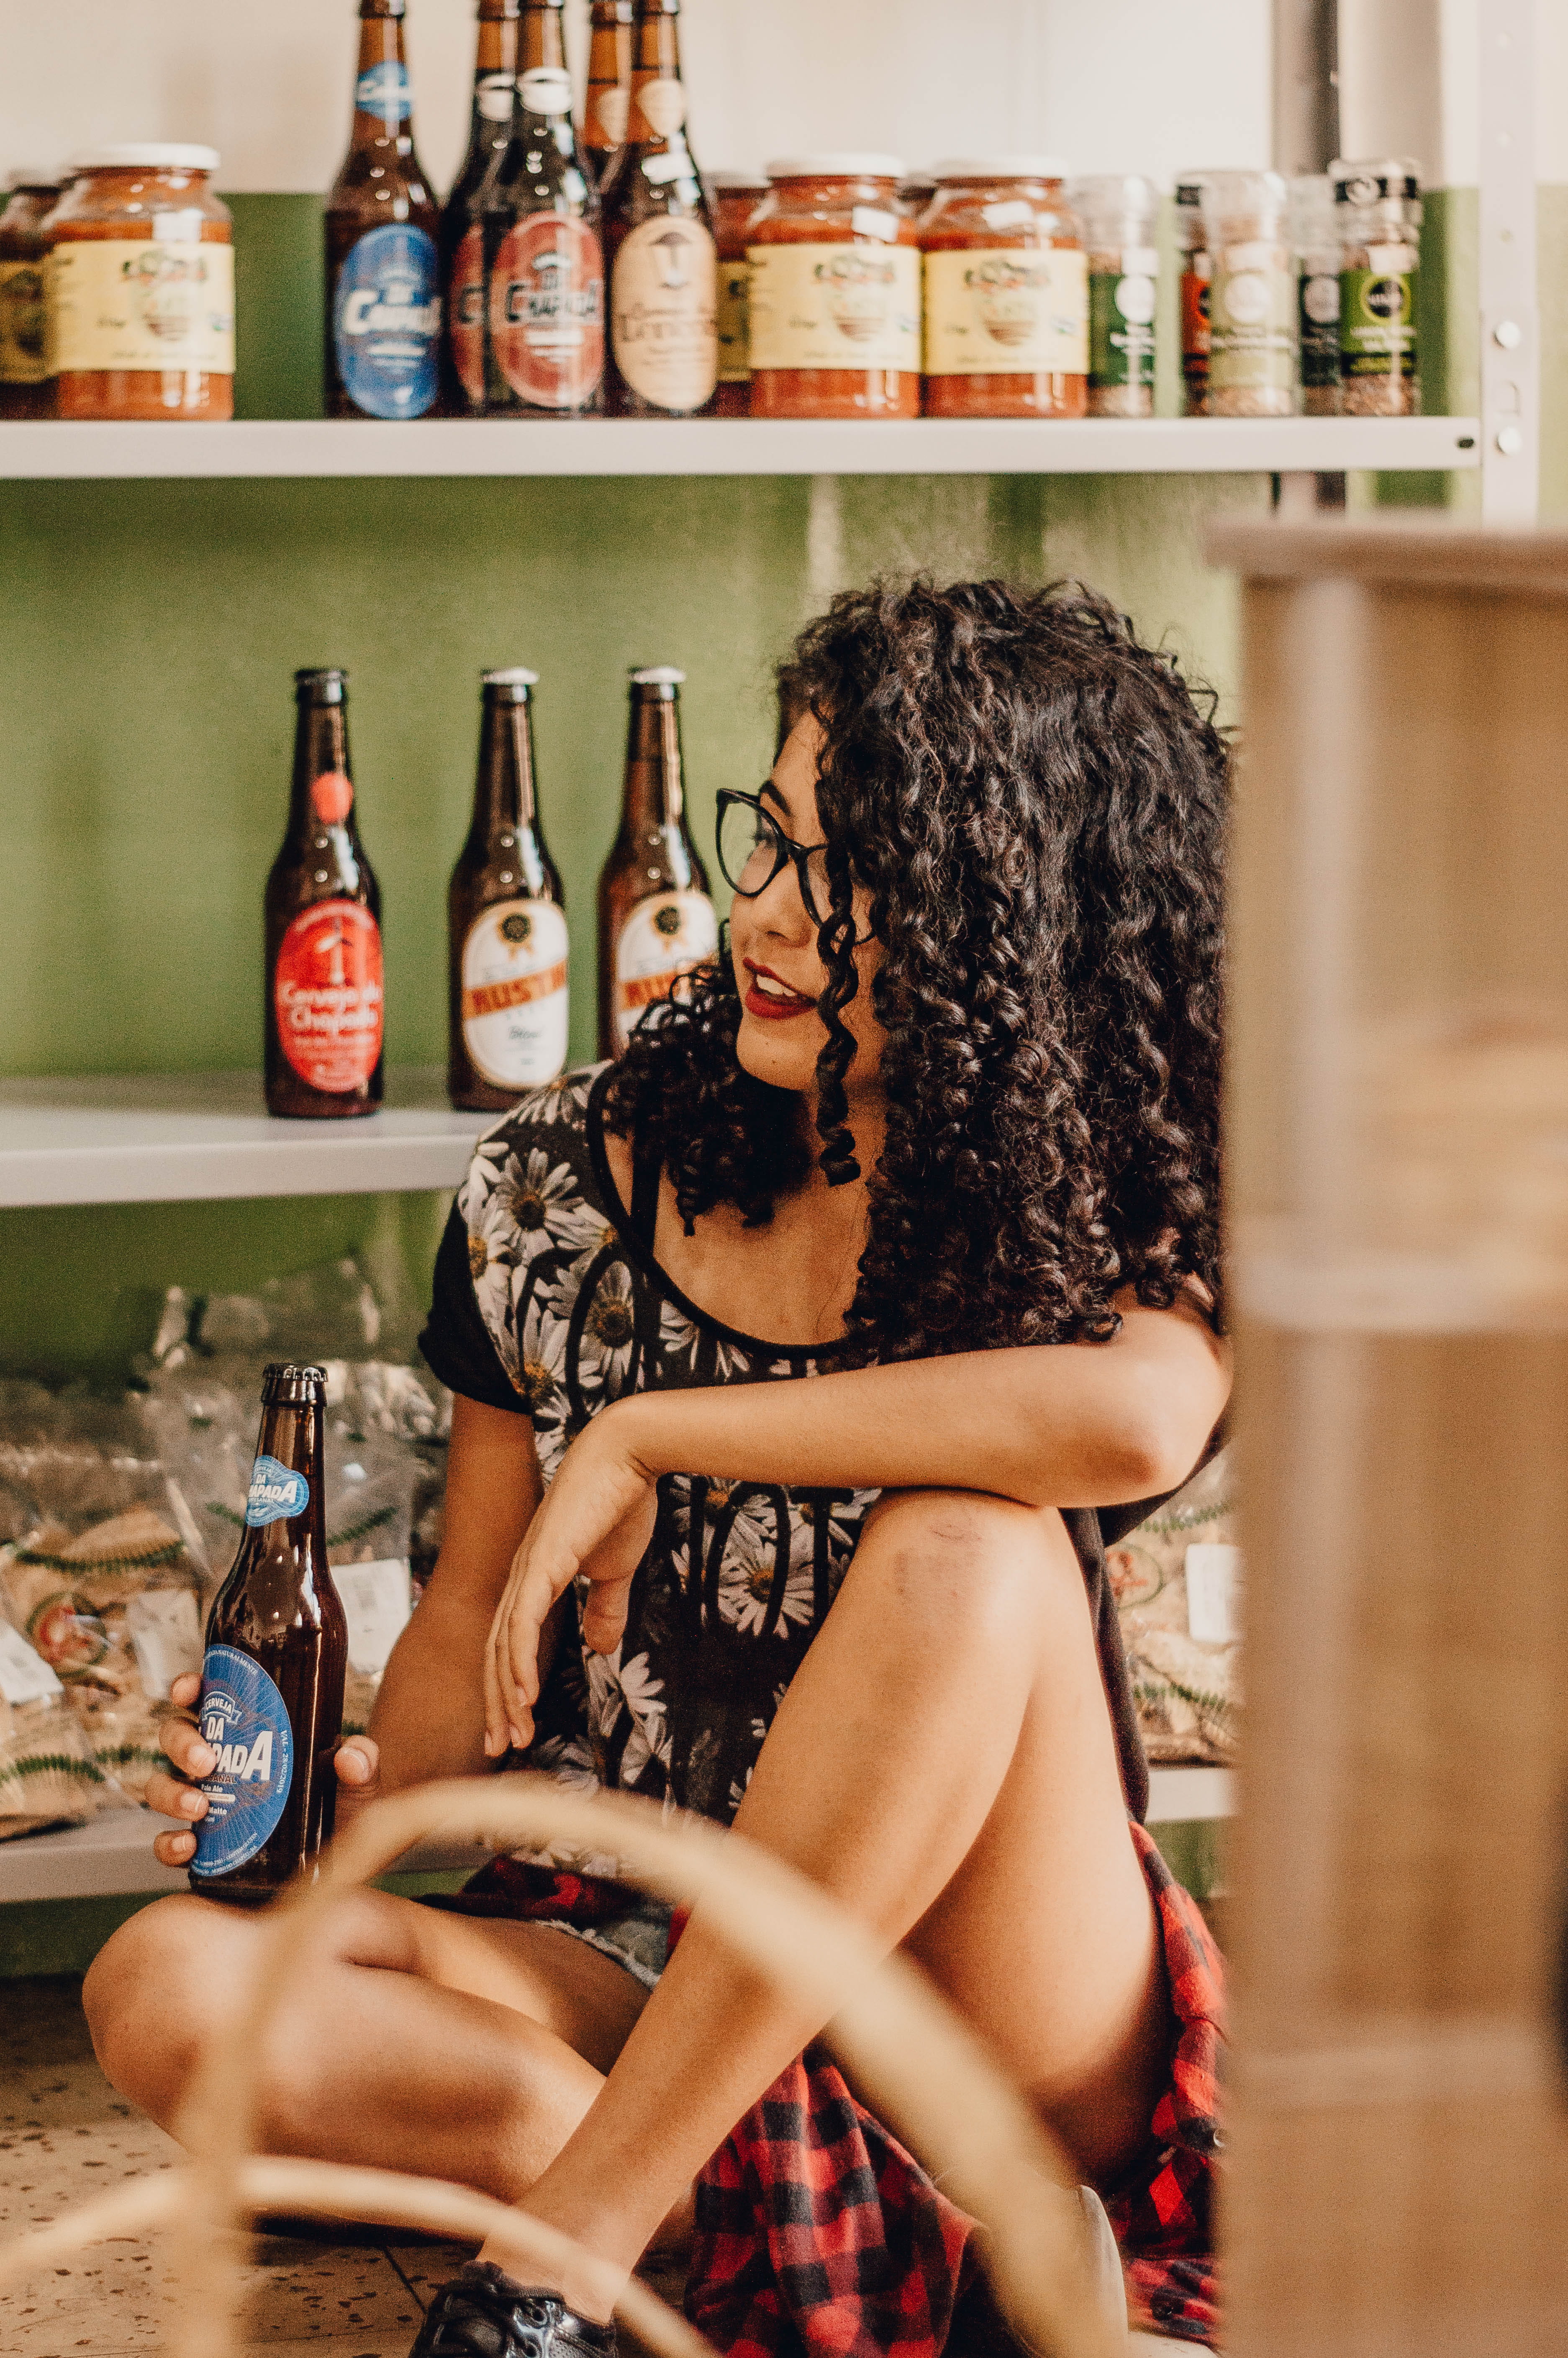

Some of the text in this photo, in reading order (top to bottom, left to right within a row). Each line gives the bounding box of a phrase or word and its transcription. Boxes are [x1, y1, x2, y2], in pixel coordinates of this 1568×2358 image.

[256, 1474, 267, 1484] DA
[205, 1697, 232, 1714] CERVEJA
[206, 1716, 224, 1740] DA
[212, 1731, 273, 1780] PADA
[276, 1753, 288, 1793] 28/02/2019
